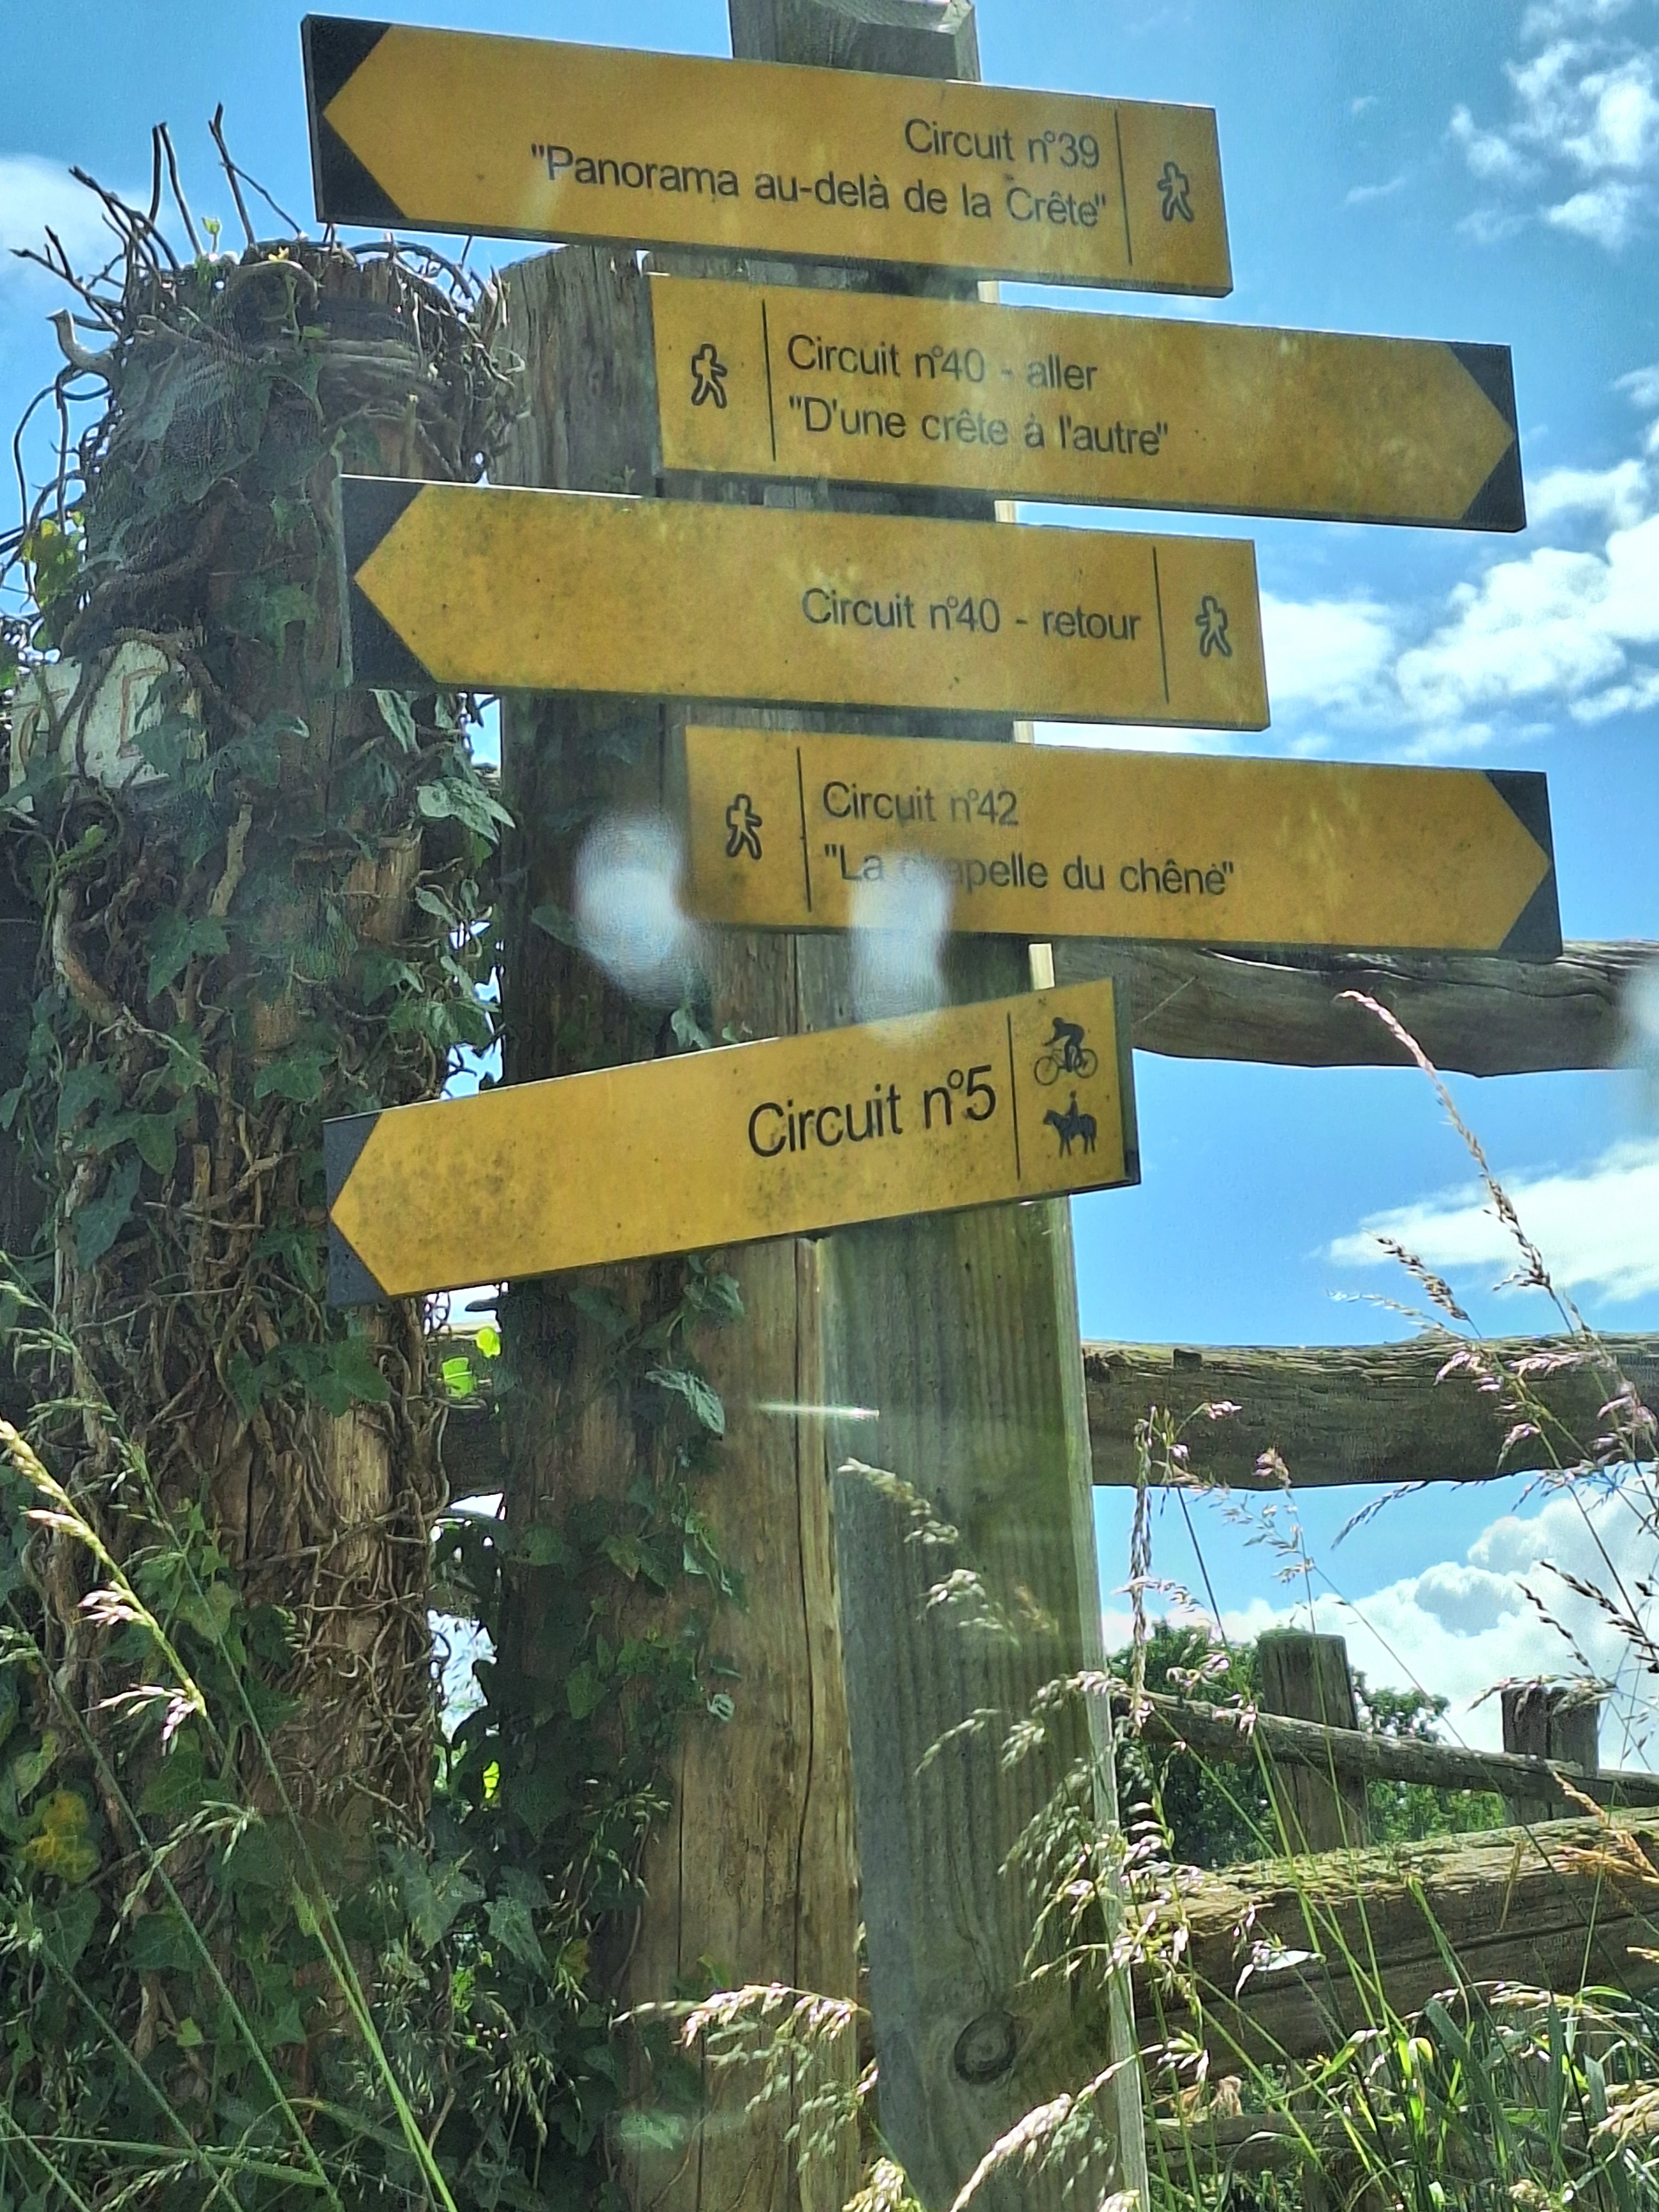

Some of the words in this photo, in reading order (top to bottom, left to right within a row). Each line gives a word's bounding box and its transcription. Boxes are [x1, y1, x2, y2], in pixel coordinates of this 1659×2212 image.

[904, 118, 1015, 162] Circuit
[531, 143, 740, 198] "Panorama
[755, 171, 890, 211] au-delà
[903, 180, 948, 217] de
[962, 183, 992, 220] la
[1006, 187, 1107, 228] Crête"
[787, 334, 901, 377] Circuit
[1027, 355, 1098, 391] aller
[789, 395, 907, 439] "D'une
[922, 409, 1008, 446] crête
[1024, 413, 1045, 449] à
[1059, 415, 1169, 456] l'autre"
[802, 587, 916, 629] Circuit
[1042, 606, 1141, 641] retour
[822, 781, 935, 822] Circuit
[823, 844, 883, 882] "La
[1063, 855, 1105, 891] du
[1120, 858, 1234, 896] chêne"
[748, 1084, 903, 1158] Circuit
